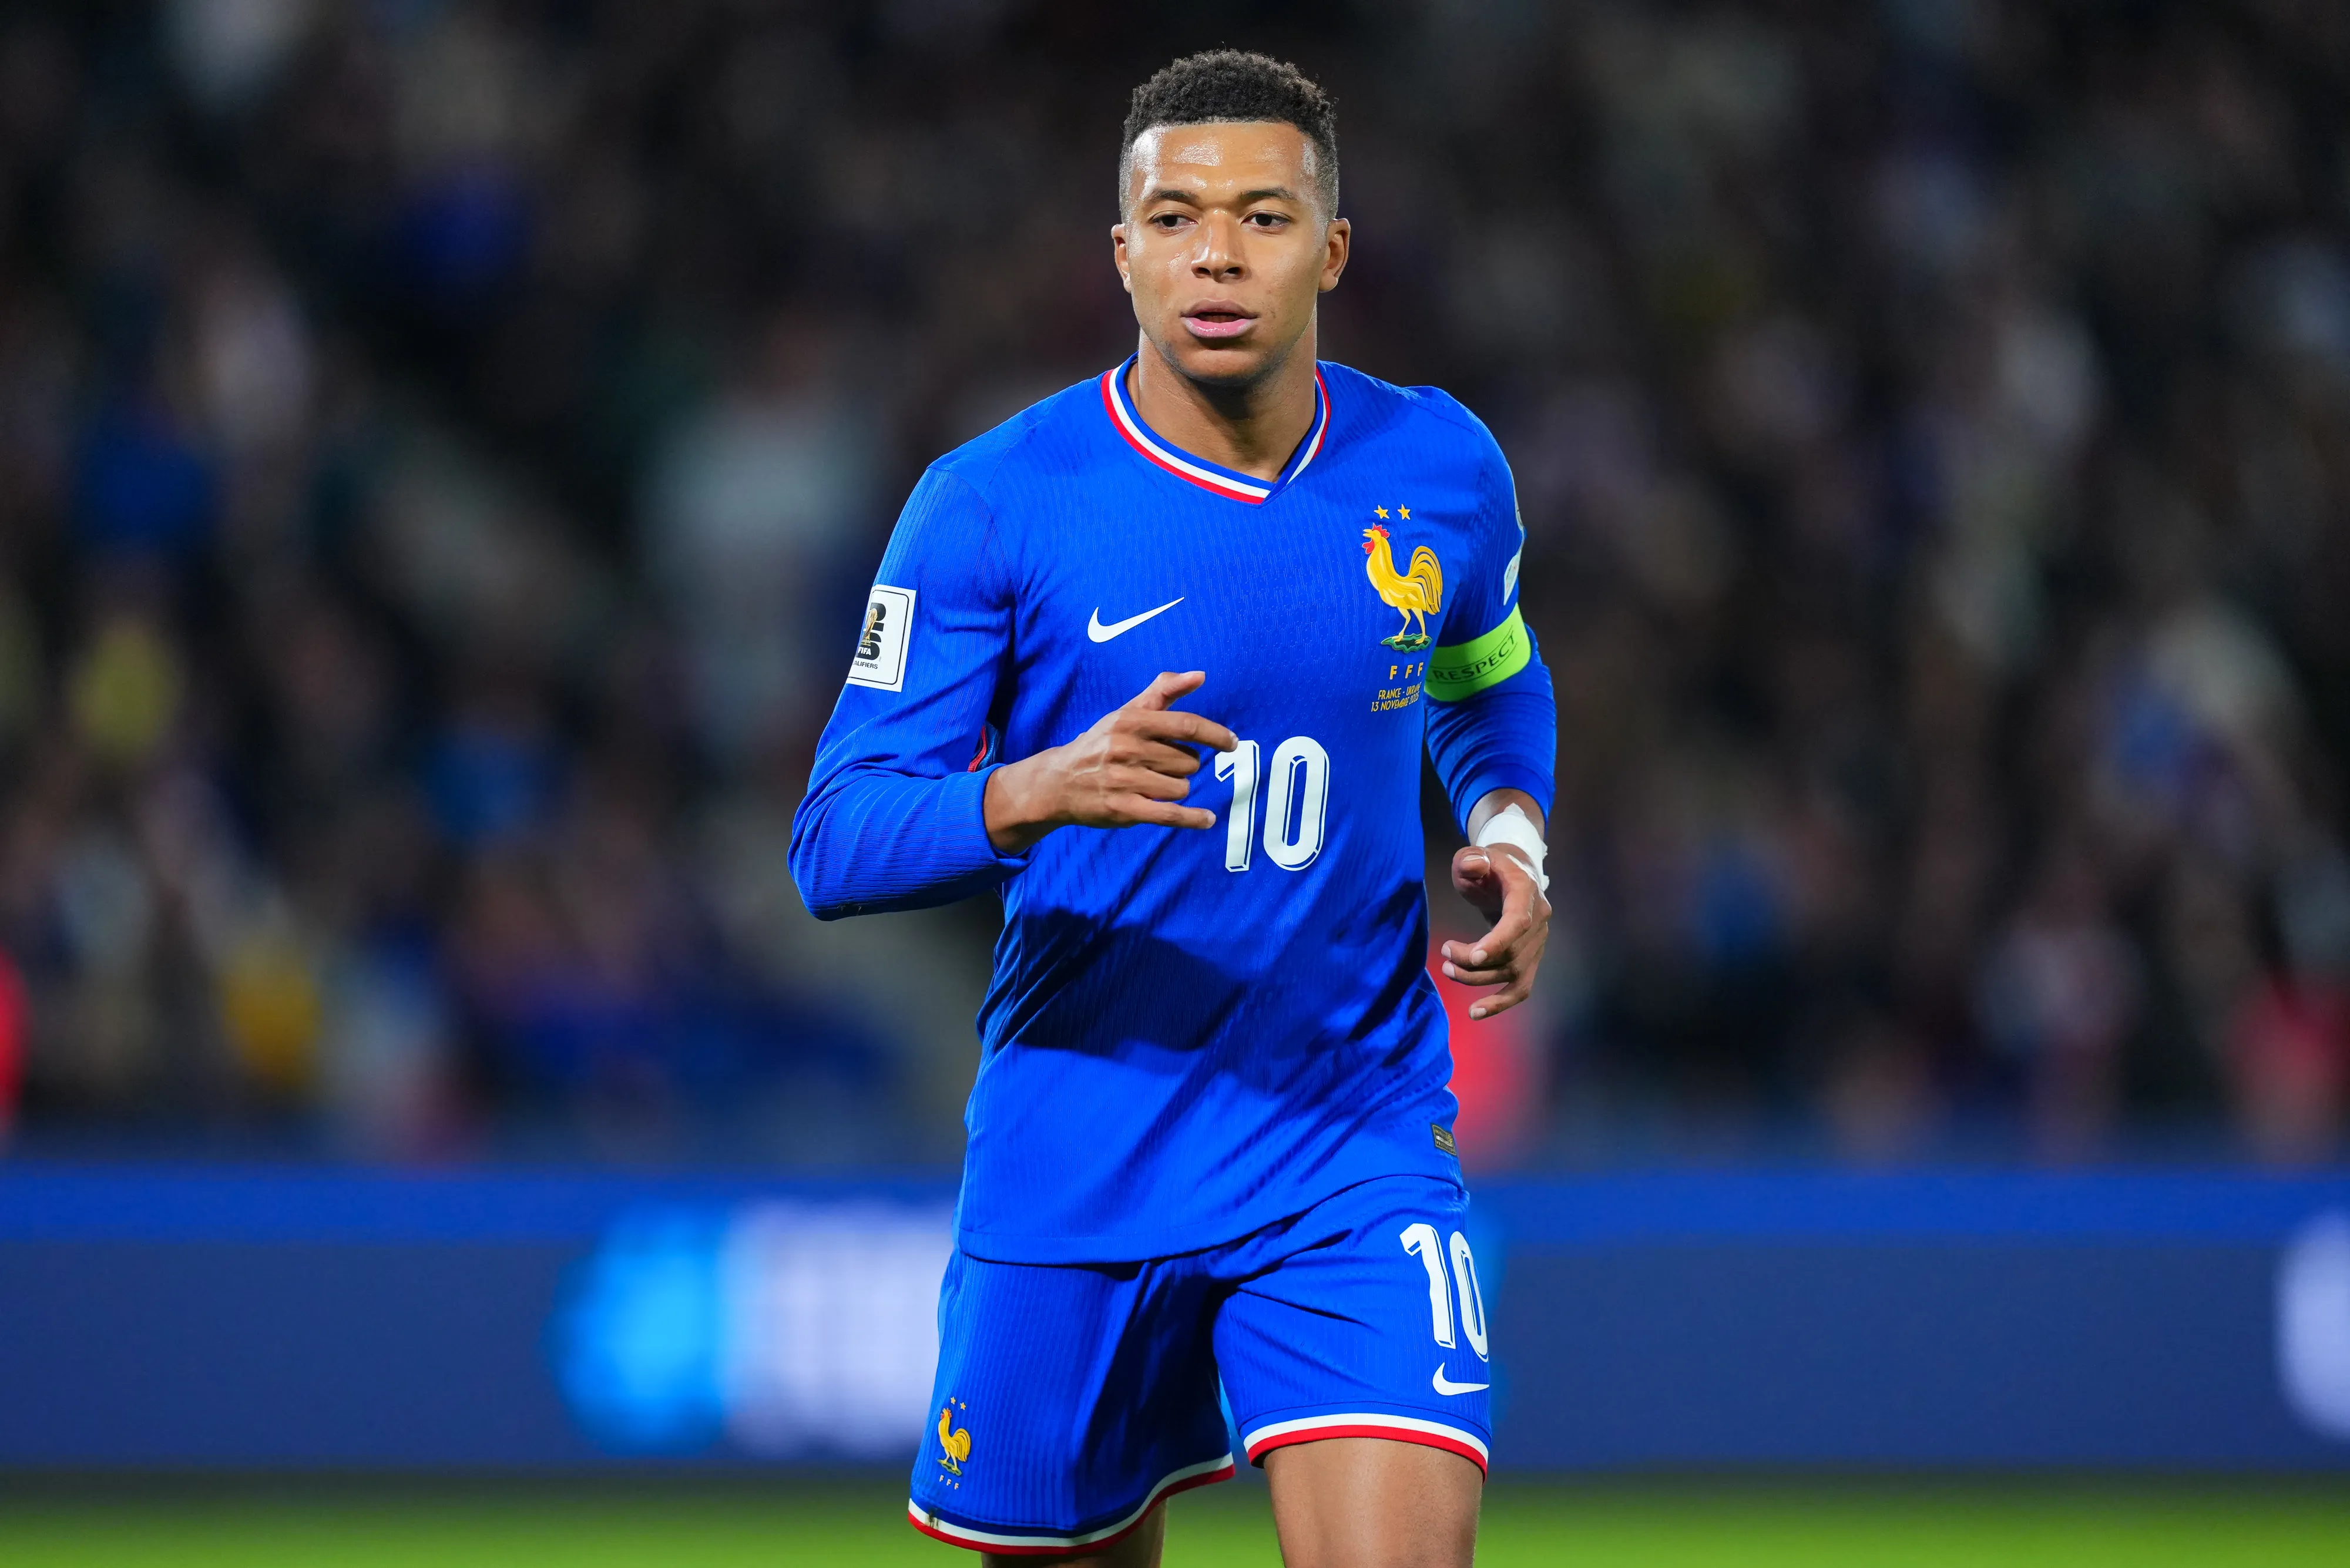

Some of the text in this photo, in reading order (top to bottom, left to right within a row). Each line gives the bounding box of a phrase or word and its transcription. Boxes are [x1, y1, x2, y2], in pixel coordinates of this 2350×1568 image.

[858, 646, 871, 656] FIFA
[1433, 634, 1514, 680] RESPECT
[853, 660, 878, 669] ALIFIERS
[1378, 688, 1401, 700] FRANCE
[1371, 701, 1379, 712] 13
[1381, 696, 1410, 711] NOVEMBRE
[1215, 736, 1330, 872] 10
[1399, 1223, 1488, 1362] 10
